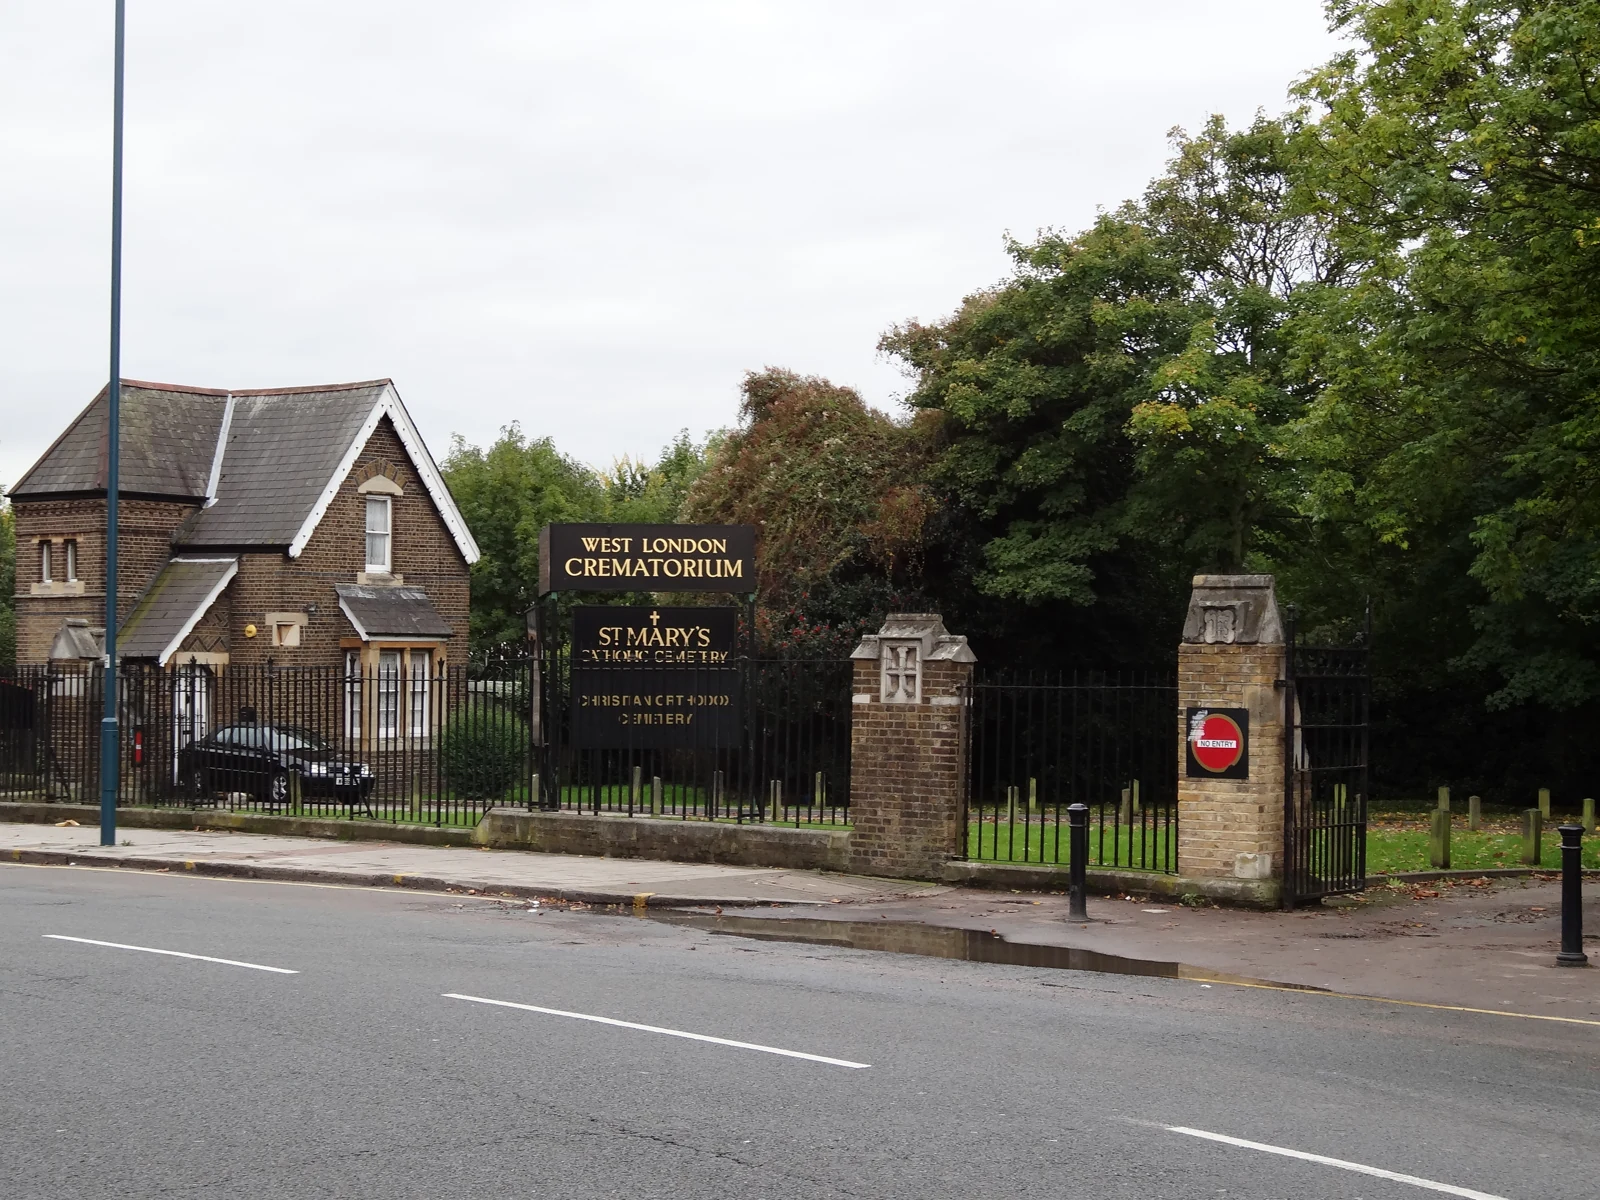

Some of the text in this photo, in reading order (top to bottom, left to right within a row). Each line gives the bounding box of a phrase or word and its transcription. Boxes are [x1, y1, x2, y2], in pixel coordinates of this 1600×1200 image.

[581, 537, 727, 554] WEST LONDON
[564, 557, 743, 578] CREMATORIUM
[626, 625, 711, 647] MARY'S
